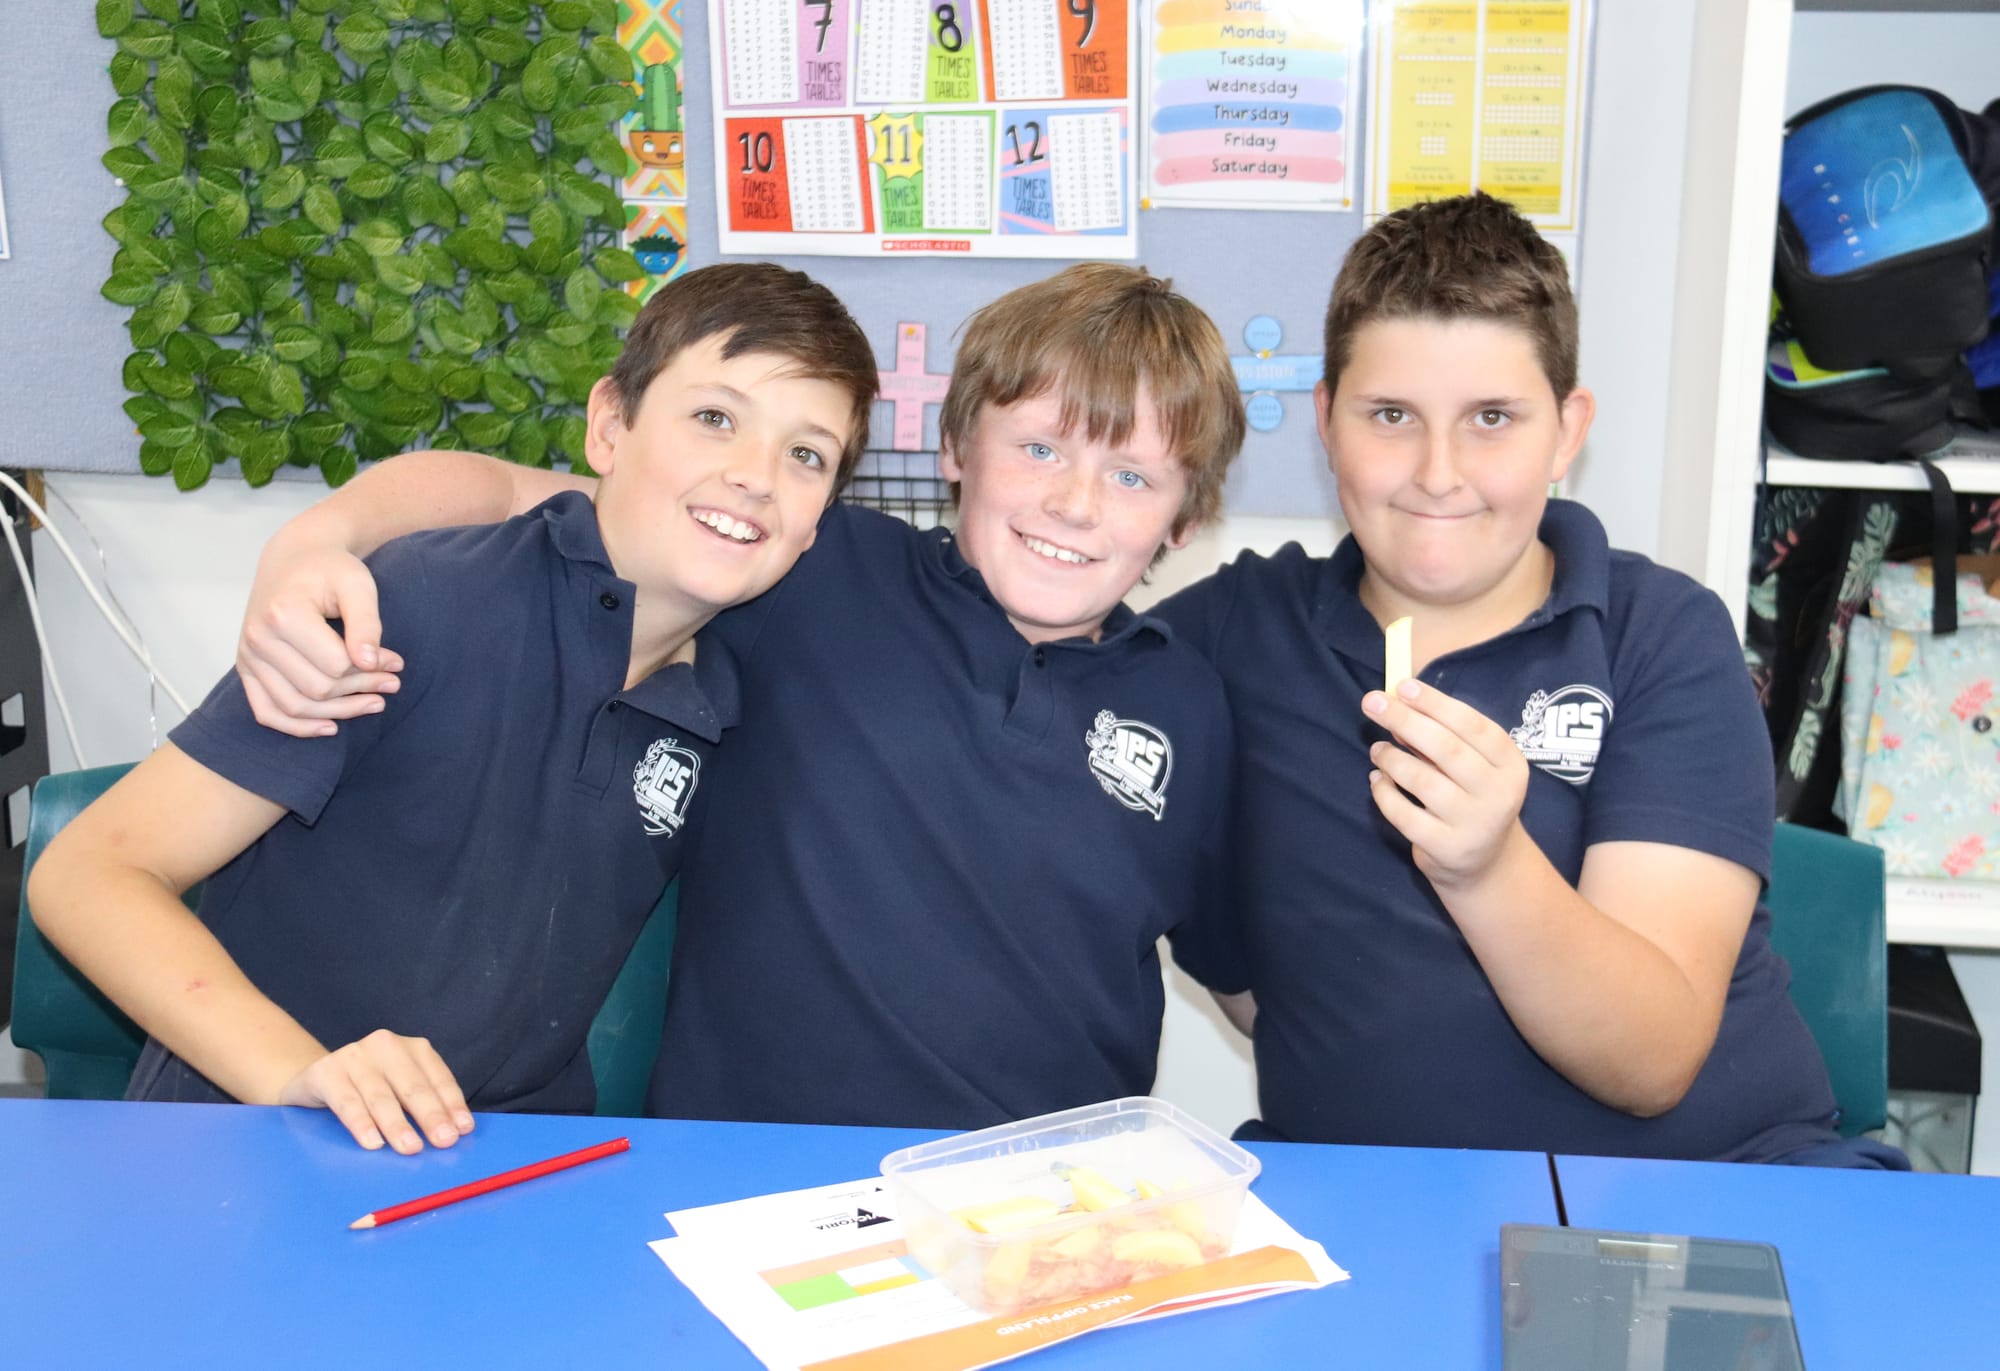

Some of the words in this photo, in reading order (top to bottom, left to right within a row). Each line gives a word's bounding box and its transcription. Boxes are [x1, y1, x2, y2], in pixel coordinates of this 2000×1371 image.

[1225, 0, 1270, 11] Sund
[805, 0, 834, 54] 7
[937, 4, 962, 52] 8
[1070, 0, 1095, 48] 9
[1220, 25, 1287, 44] Monday
[804, 61, 841, 82] TIMES
[935, 56, 971, 78] TIMES
[1070, 50, 1107, 74] TIMES
[1219, 51, 1287, 72] Tuesday
[804, 83, 842, 101] TABLES
[932, 80, 971, 98] TABLES
[1073, 75, 1110, 95] TABLES
[1207, 79, 1299, 99] Wednesday
[1213, 105, 1290, 125] Thursday
[881, 124, 912, 165] 11
[1005, 120, 1045, 166] 12
[1224, 132, 1277, 151] Friday
[737, 131, 775, 174] 10
[1211, 159, 1289, 178] Saturday
[742, 178, 776, 203] TIMES
[883, 186, 918, 208] TIMES
[1011, 176, 1046, 199] TIMES
[741, 201, 779, 219] TABLES
[885, 210, 922, 227] TABLES
[1014, 198, 1051, 219] TABLES
[894, 241, 969, 250] SCHOLASTIC
